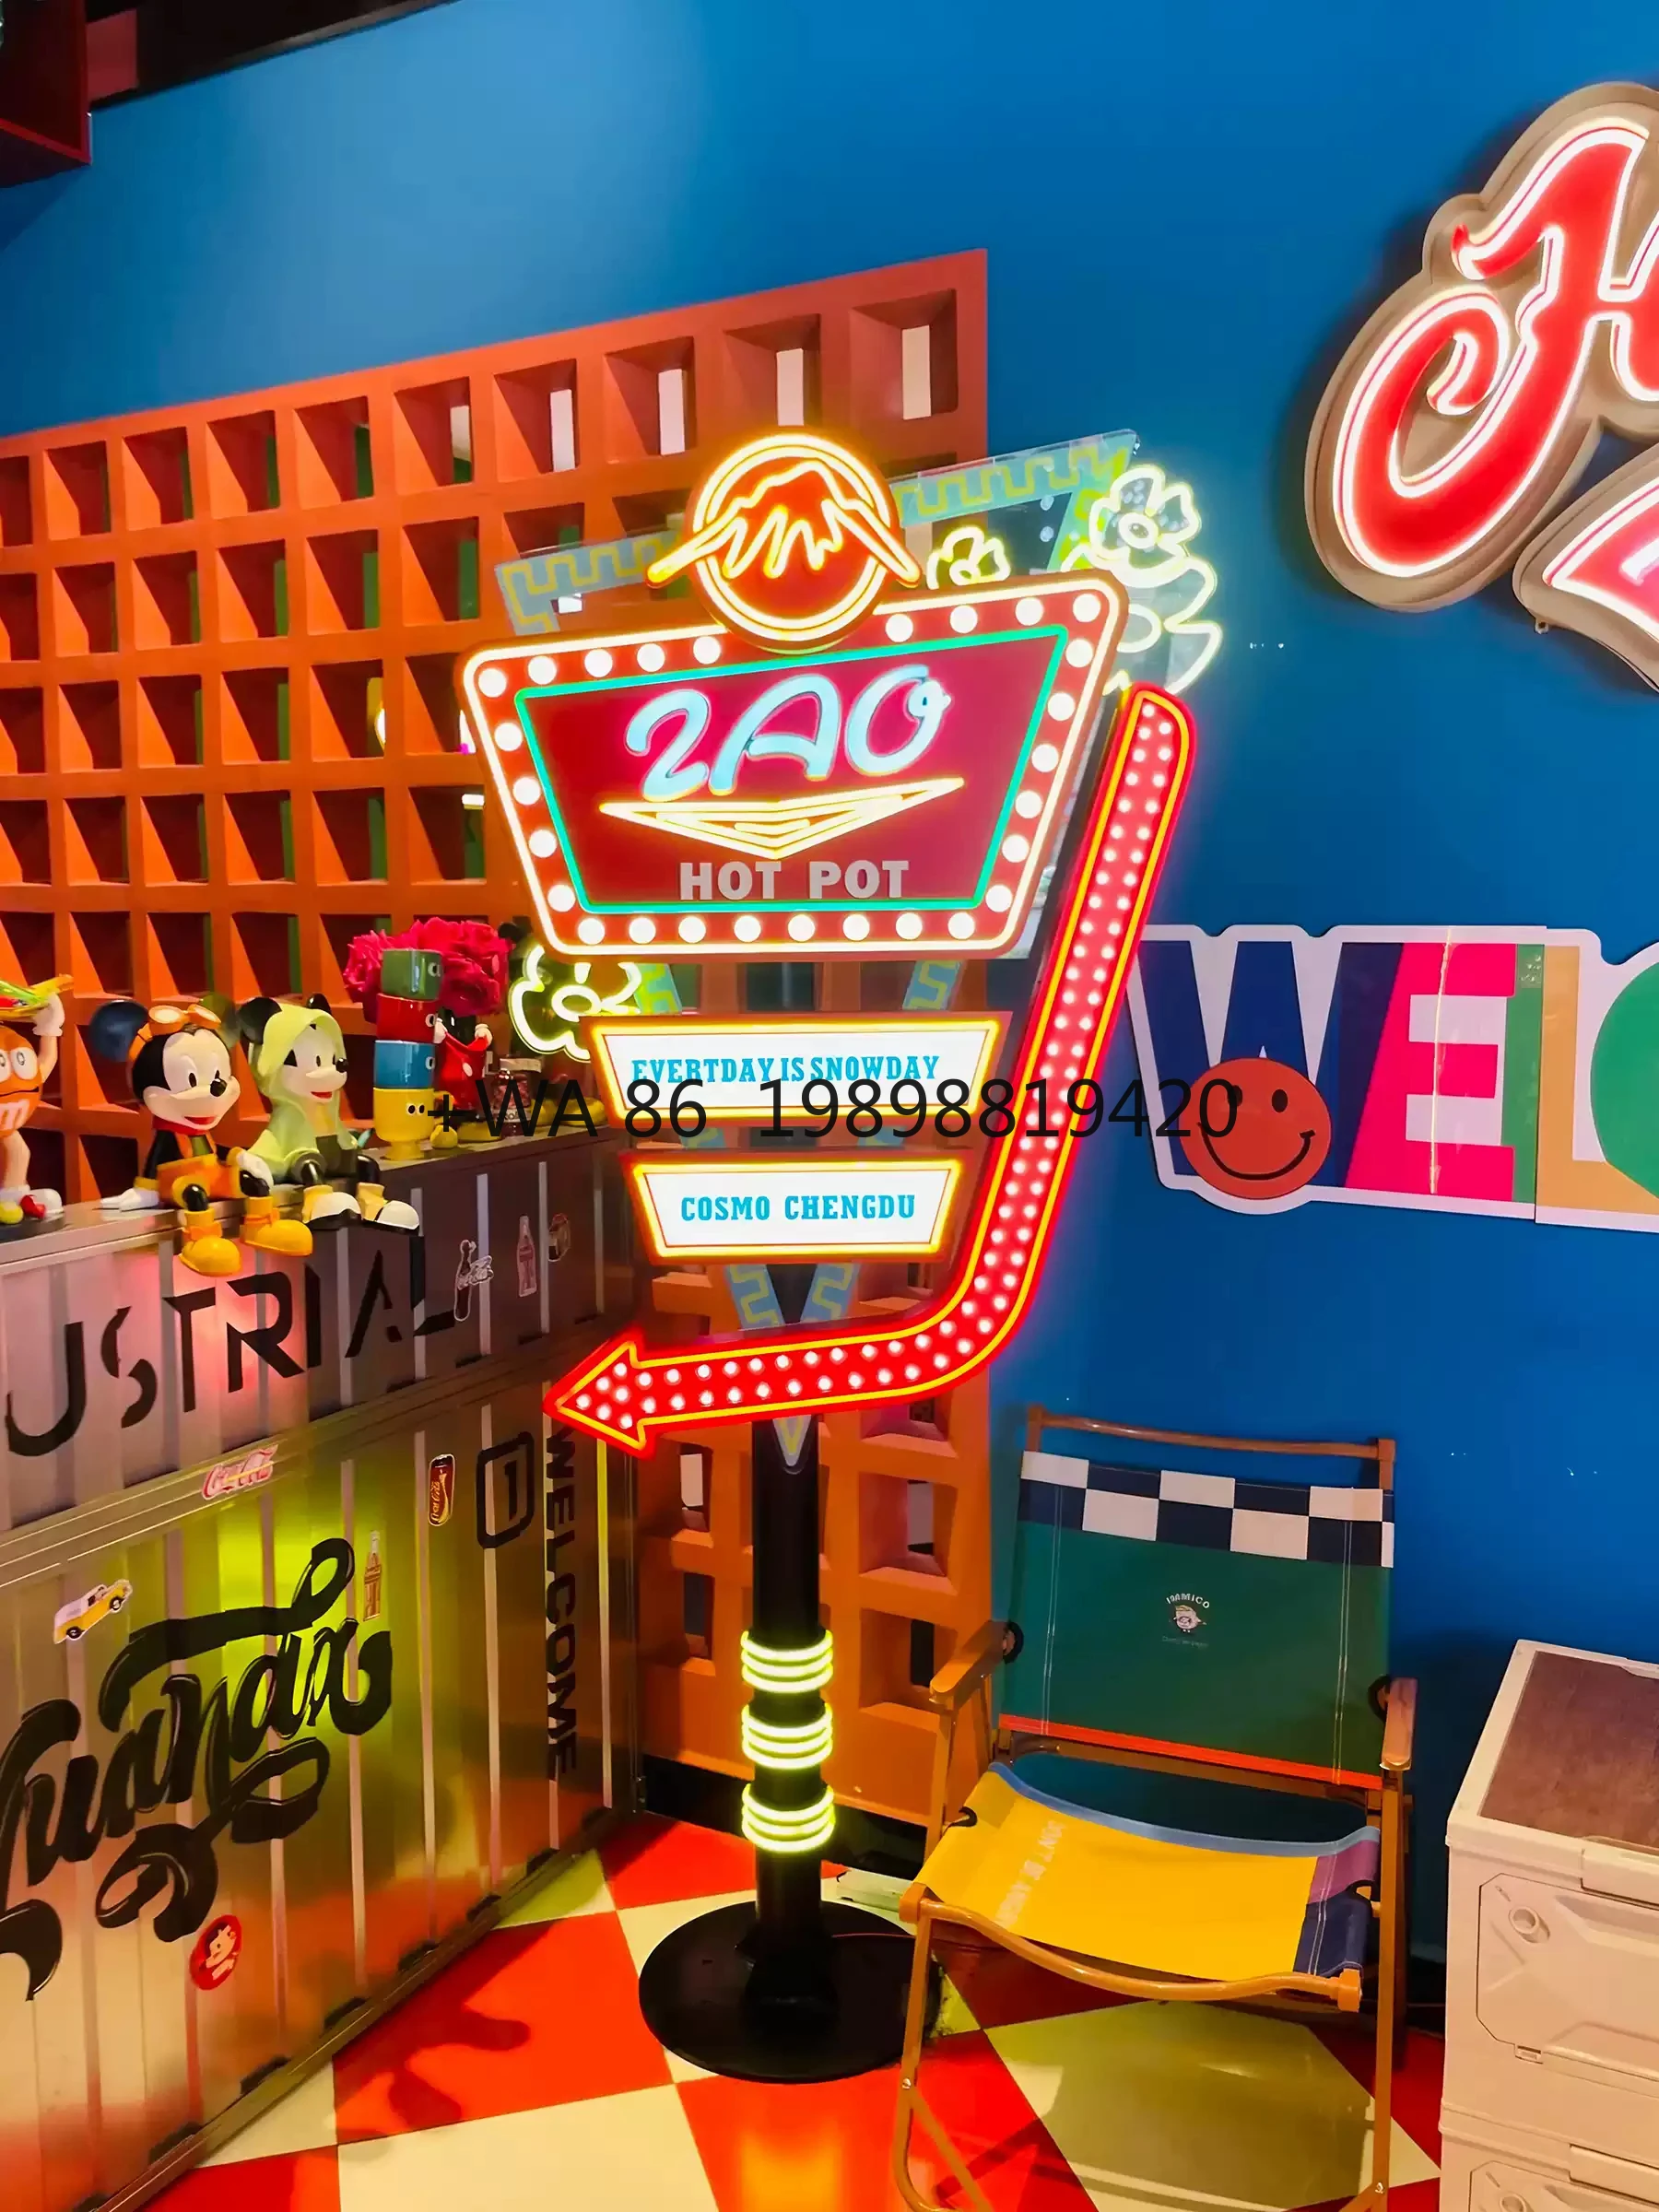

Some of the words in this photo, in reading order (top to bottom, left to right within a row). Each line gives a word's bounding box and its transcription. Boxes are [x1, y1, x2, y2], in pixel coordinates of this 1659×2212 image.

[679, 860, 782, 900] HOT
[808, 859, 909, 900] POT
[780, 1056, 805, 1082] IS
[809, 1055, 940, 1081] SNOWDAY
[681, 1195, 771, 1221] COSMO
[783, 1194, 915, 1221] CHENGDU
[547, 1426, 578, 1781] WELCOME
